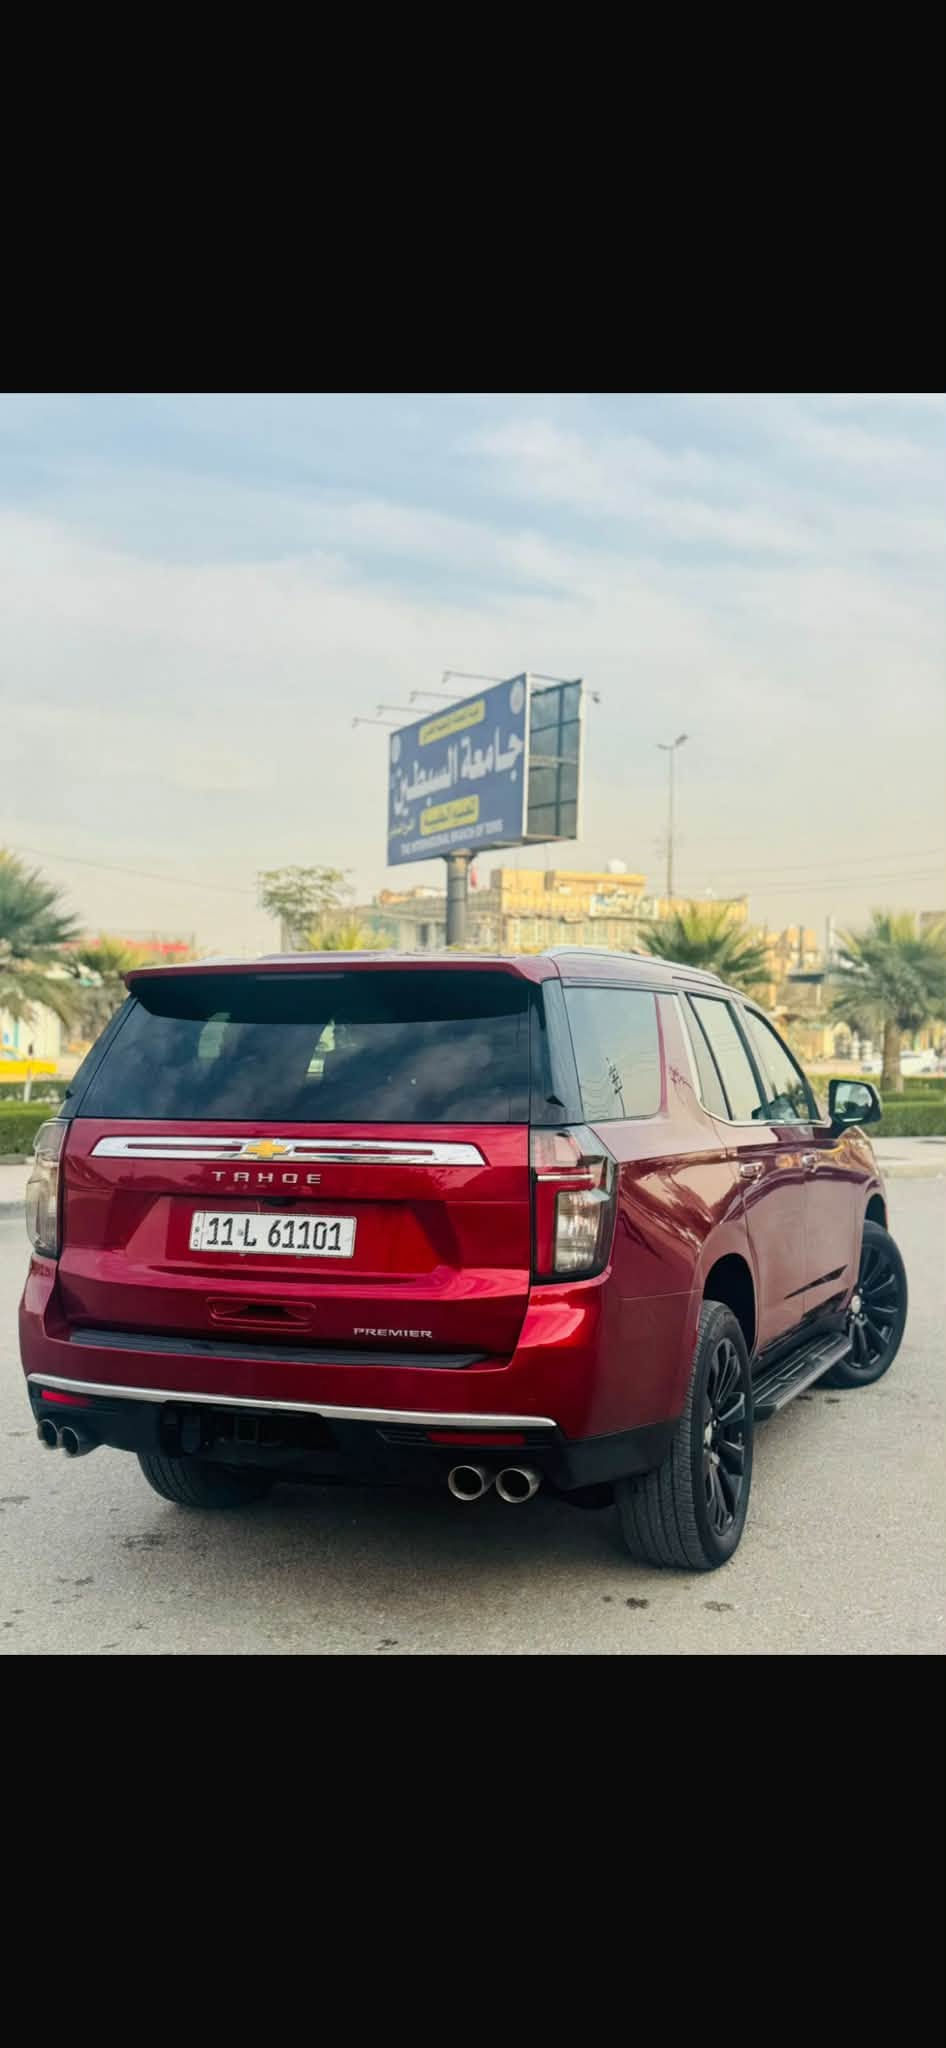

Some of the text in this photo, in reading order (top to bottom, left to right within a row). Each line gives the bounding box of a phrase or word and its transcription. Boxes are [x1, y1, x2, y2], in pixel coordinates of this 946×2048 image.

[461, 727, 524, 781] جامعة
[393, 742, 458, 816] السبطين
[211, 1171, 322, 1184] TAHOE
[207, 1217, 341, 1250] 11 L 61101
[353, 1327, 432, 1338] PREMIER
